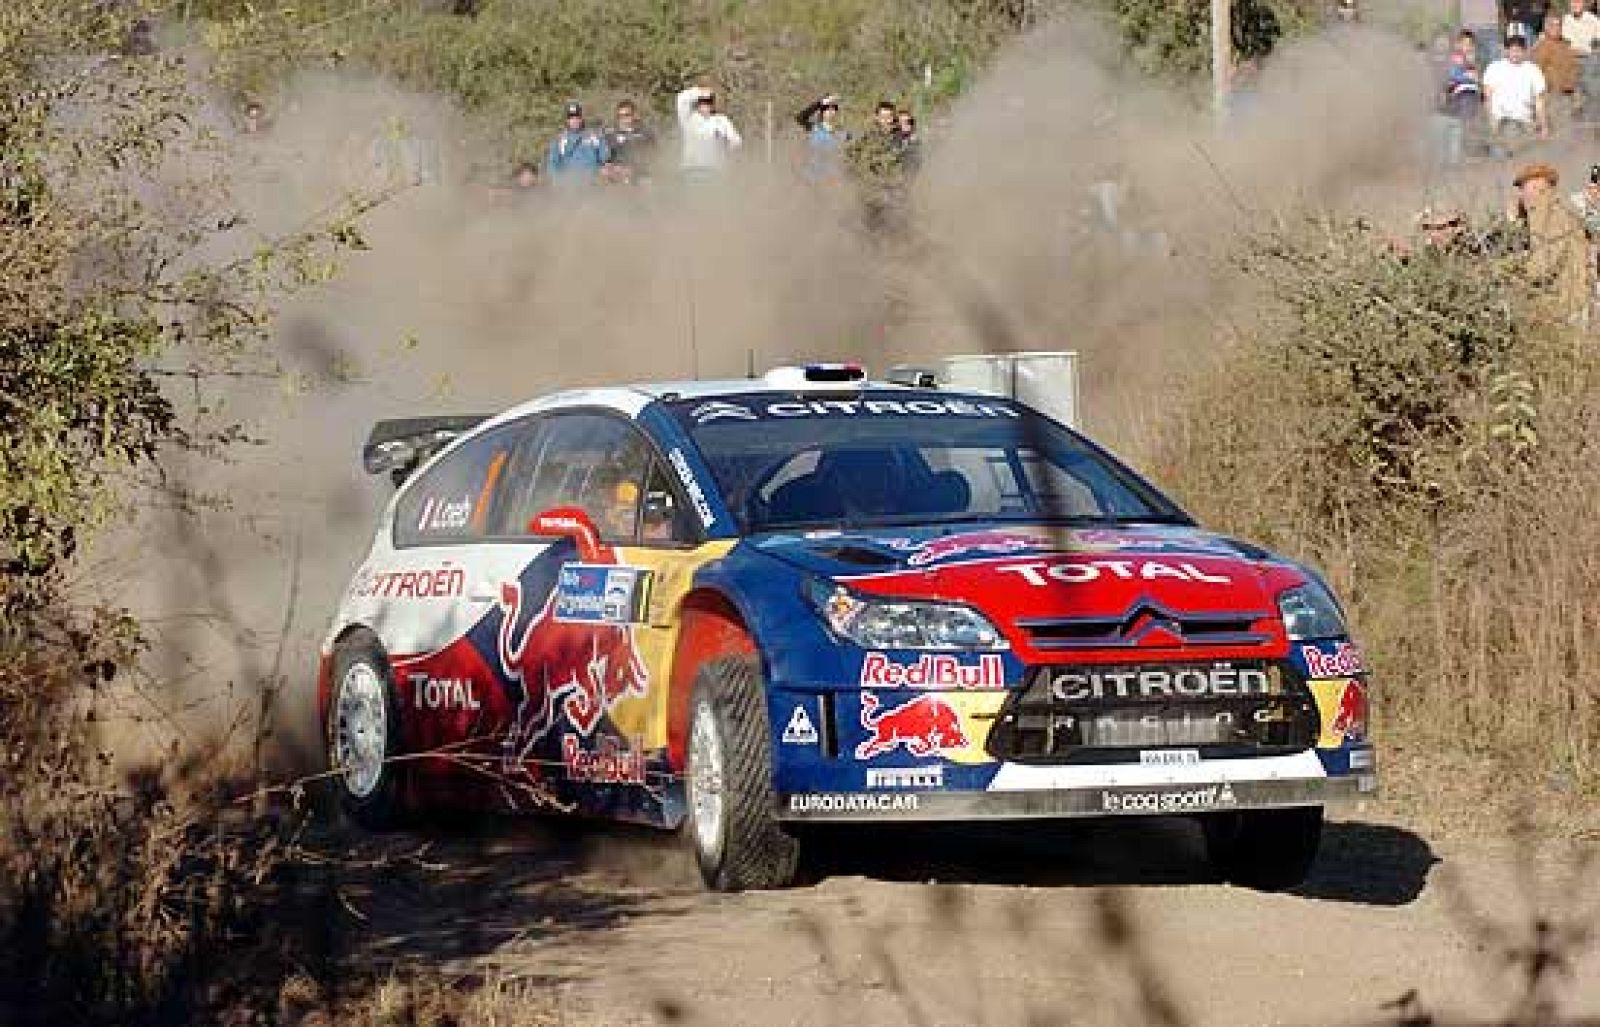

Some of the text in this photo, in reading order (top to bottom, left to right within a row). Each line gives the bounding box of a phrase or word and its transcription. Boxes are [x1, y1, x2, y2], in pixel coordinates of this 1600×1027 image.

[996, 560, 1232, 586] TOTAL
[860, 652, 1003, 687] Red Bull
[1051, 662, 1268, 700] CITROËN
[408, 673, 480, 711] TOTAL
